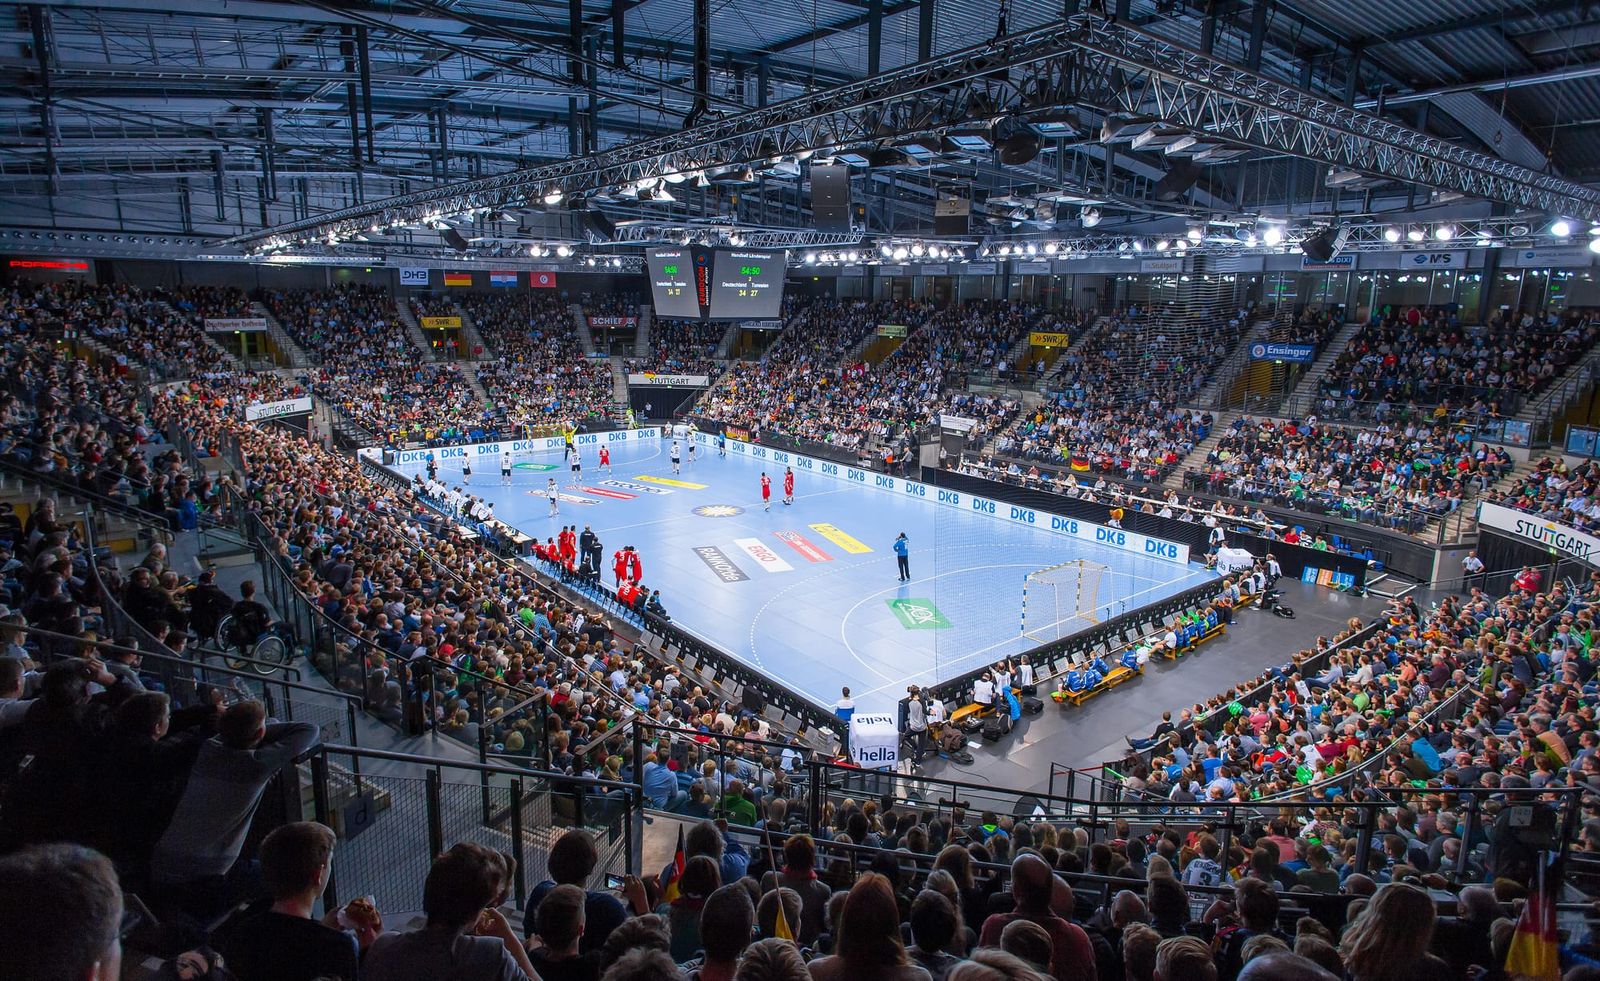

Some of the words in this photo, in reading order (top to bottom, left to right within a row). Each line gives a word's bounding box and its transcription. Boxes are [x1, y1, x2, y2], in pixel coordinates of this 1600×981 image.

[402, 271, 427, 279] DHB
[741, 266, 760, 275] 54:50
[1267, 345, 1311, 357] Ensinger
[402, 451, 426, 462] DKB
[441, 448, 464, 458] DKB
[478, 444, 500, 454] DKB
[578, 435, 597, 444] DKB
[609, 432, 627, 441] DKB
[638, 429, 655, 438] DKB
[732, 442, 745, 452] DKB
[752, 447, 766, 458] DKB
[774, 452, 789, 463] DKB
[797, 457, 813, 469] DKB
[822, 463, 838, 475] DKB
[848, 469, 865, 482] DKB
[875, 475, 894, 489] DKB
[905, 482, 926, 496] DKB
[938, 490, 959, 505] DKB
[973, 498, 996, 514] DKB
[1010, 507, 1035, 524] DKB
[1051, 516, 1078, 534] DKB
[1096, 527, 1126, 546] DKB
[1145, 539, 1177, 559] DKB
[1515, 519, 1591, 558] STUTTGART
[748, 545, 777, 562] ERGO
[904, 603, 940, 624] AOK
[857, 717, 893, 725] hella
[860, 747, 896, 761] hella
